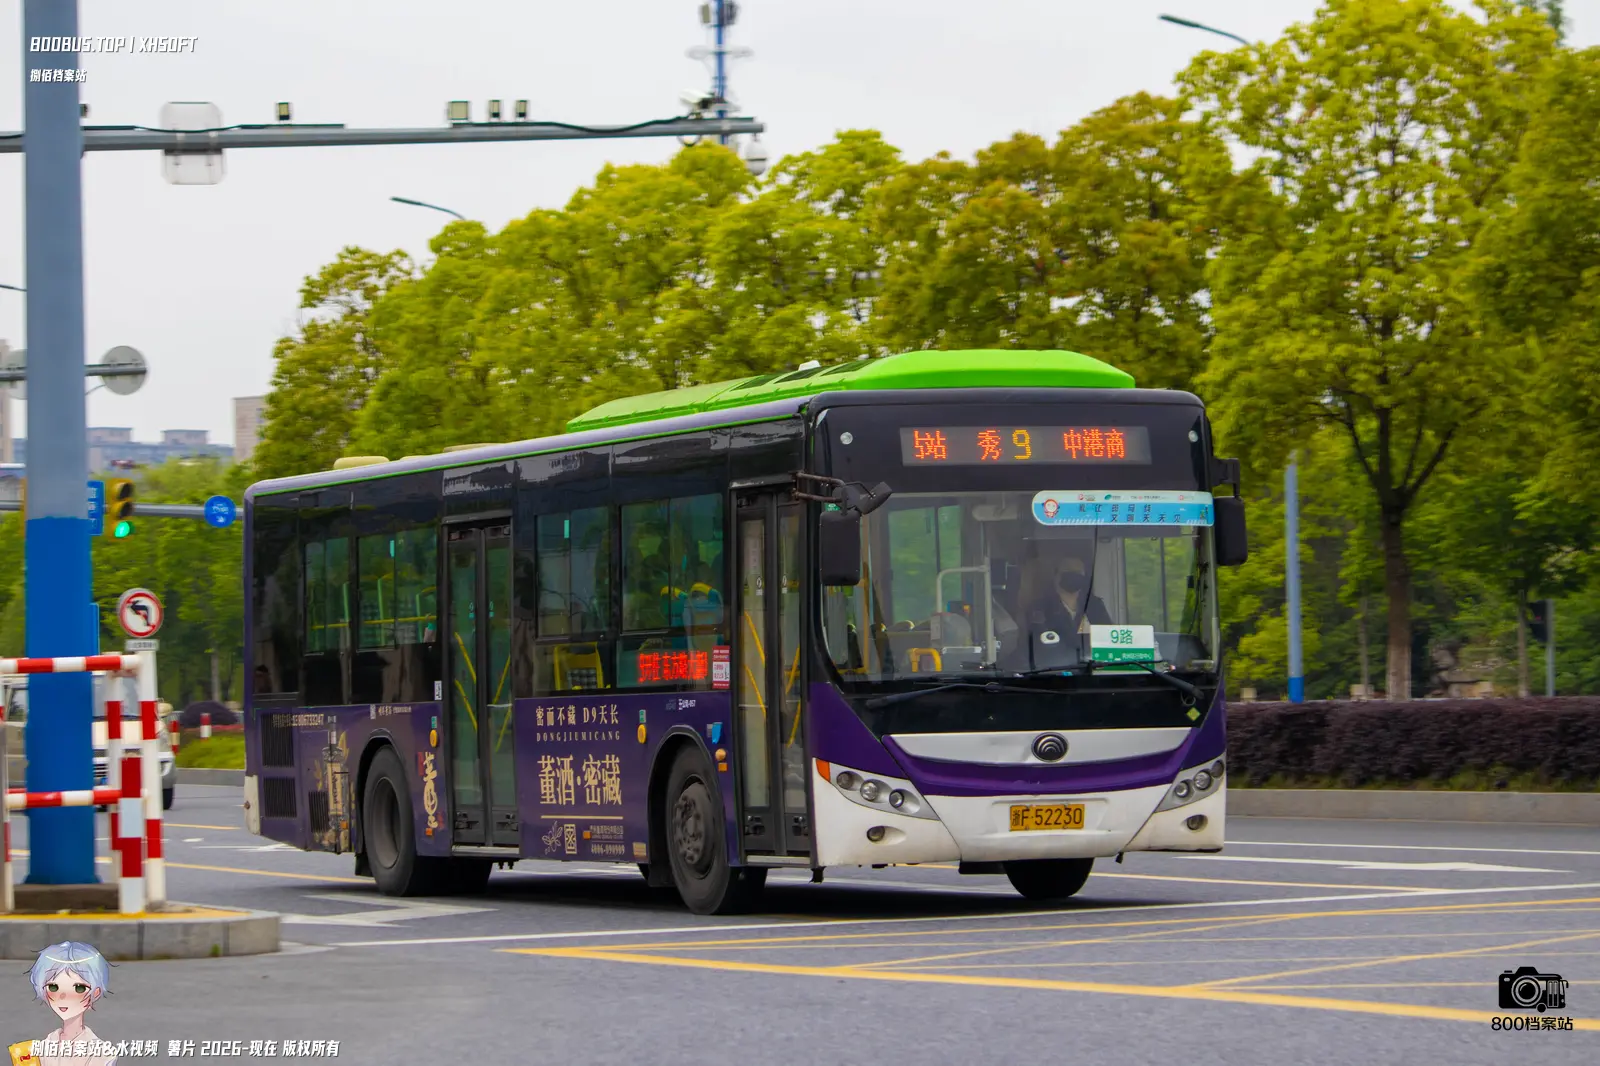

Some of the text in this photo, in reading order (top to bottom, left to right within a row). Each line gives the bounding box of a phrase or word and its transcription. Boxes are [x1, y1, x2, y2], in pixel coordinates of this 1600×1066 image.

[1012, 429, 1032, 461] 9
[1110, 628, 1134, 645] 9路
[536, 731, 620, 742] DONGJIUMICANG
